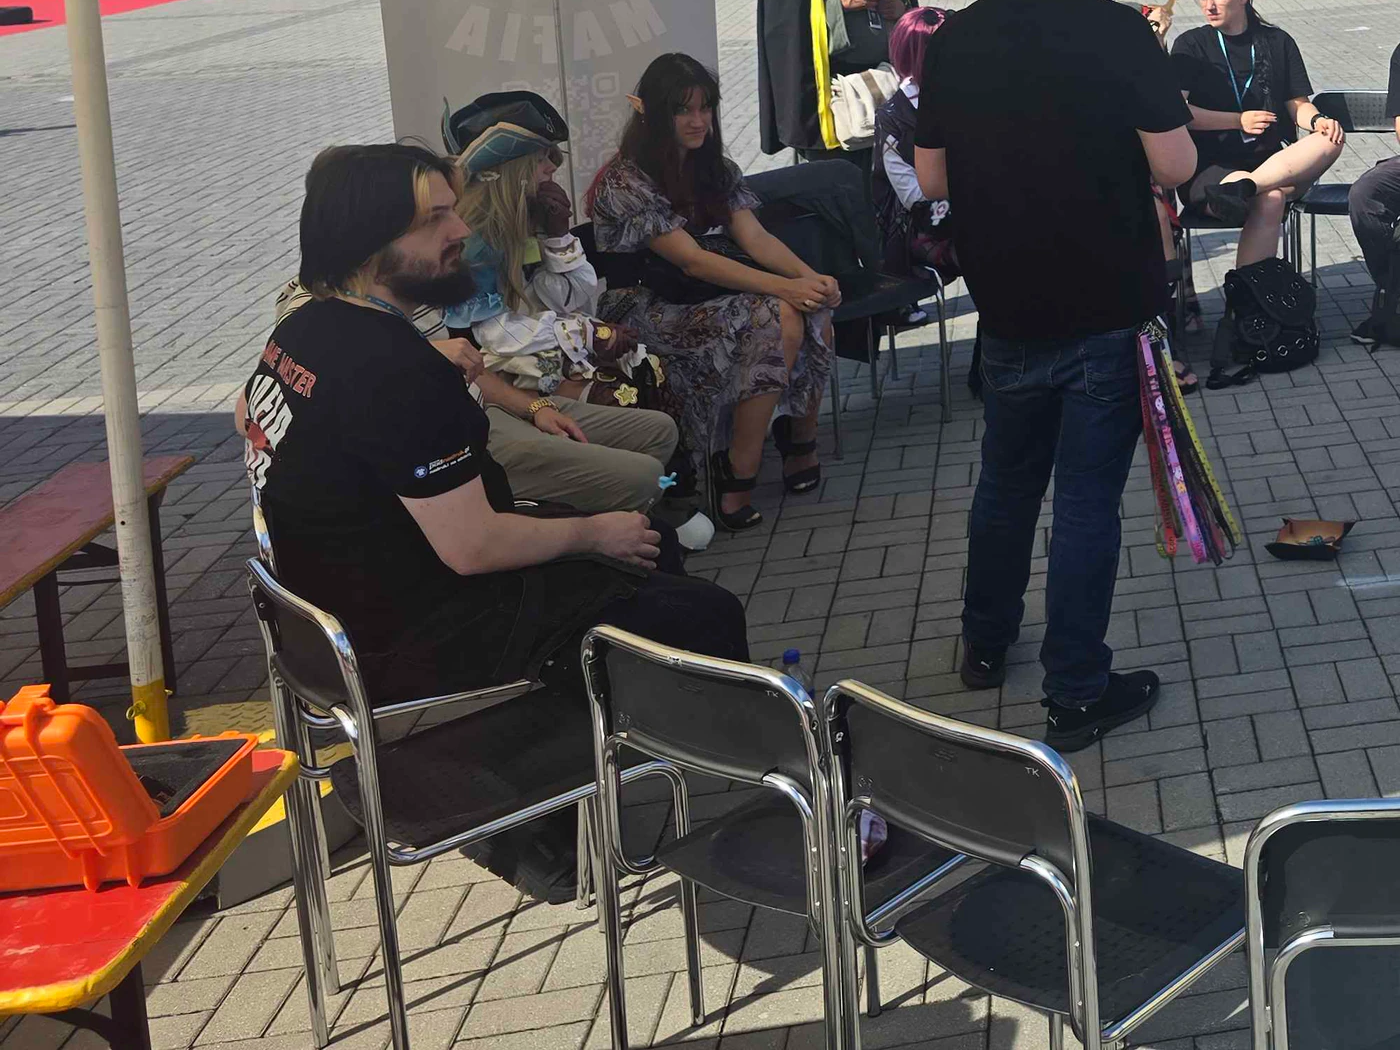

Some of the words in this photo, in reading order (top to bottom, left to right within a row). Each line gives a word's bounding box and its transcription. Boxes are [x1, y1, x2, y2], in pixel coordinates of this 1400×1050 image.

[276, 352, 317, 398] MASTER
[765, 690, 779, 698] TK
[1024, 766, 1040, 778] TK
